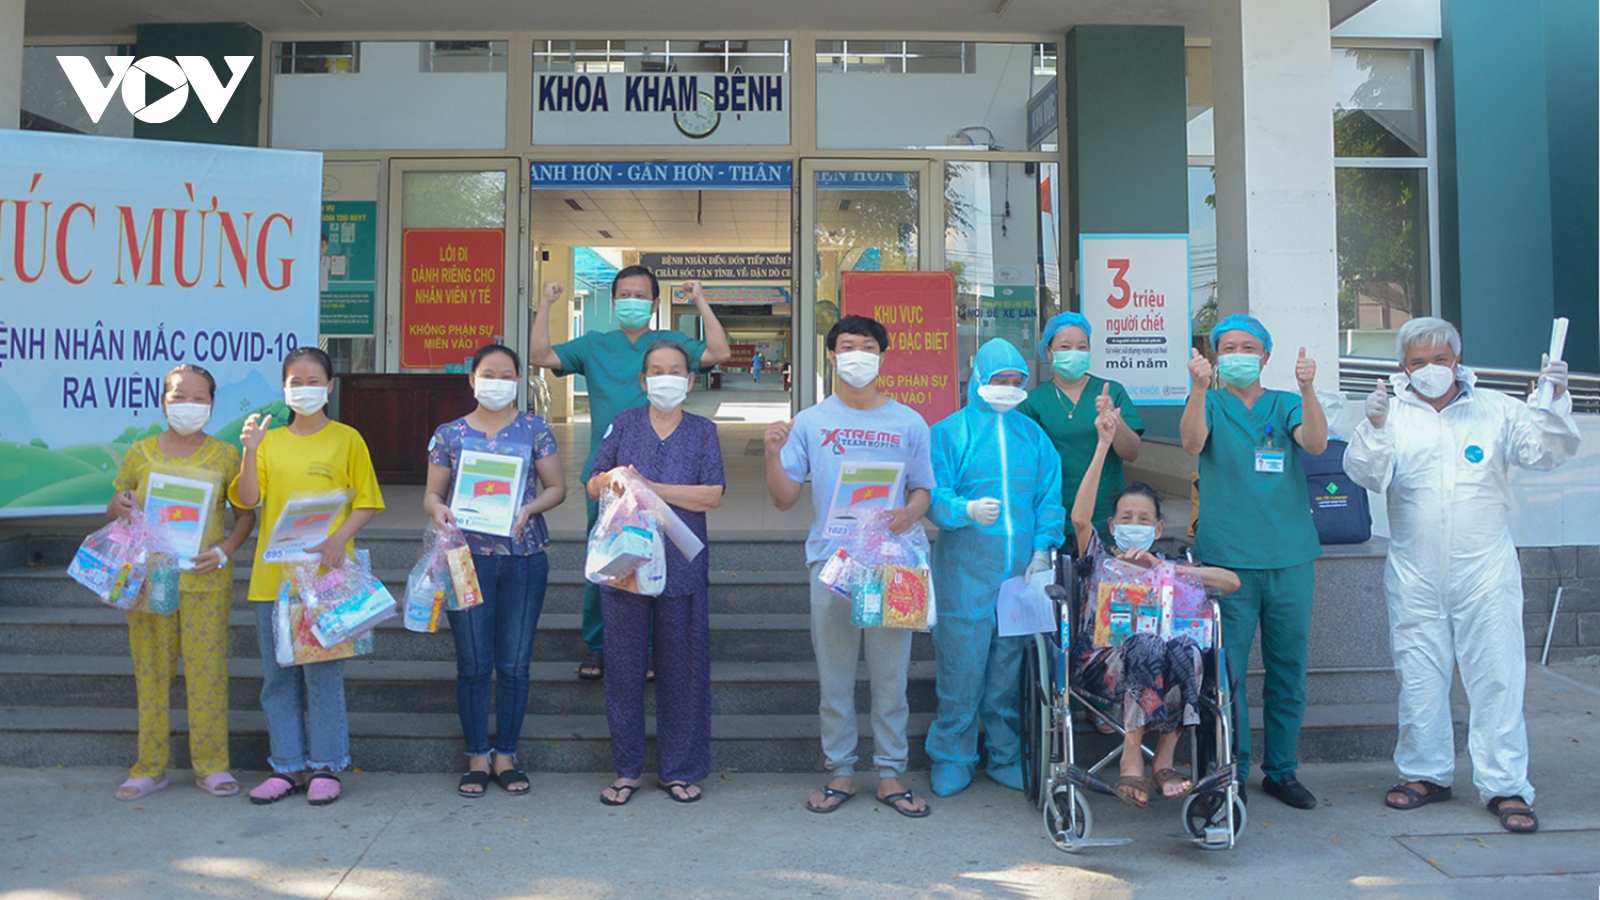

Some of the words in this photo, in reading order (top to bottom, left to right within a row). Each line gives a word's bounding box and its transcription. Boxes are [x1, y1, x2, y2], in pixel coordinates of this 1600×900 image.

[538, 75, 609, 112] KHOA
[625, 64, 698, 112] KHÁM
[714, 66, 783, 121] BỆNH
[572, 162, 613, 181] HƠN
[673, 162, 715, 181] HƠN
[729, 162, 783, 181] THÂN
[0, 172, 98, 285] ÚC
[112, 181, 296, 291] MỪNG
[440, 243, 456, 262] LỐI
[458, 246, 468, 262] ĐI
[661, 254, 683, 266] BỆNH
[684, 254, 707, 265] NHÂN
[411, 264, 439, 283] DÀNH
[441, 264, 472, 283] RIÊNG
[473, 267, 496, 283] CHO
[679, 267, 695, 278] SÓC
[415, 285, 443, 304] NHÂN
[445, 285, 467, 304] VIÊN
[469, 289, 477, 304] Y
[478, 285, 491, 304] TẾ
[1106, 259, 1131, 309] 3
[1133, 289, 1165, 313] triệu
[874, 305, 898, 324] KHU
[900, 305, 924, 329] VỰC
[1003, 308, 1016, 317] XE
[409, 322, 446, 336] KHÔNG
[479, 324, 495, 338] SỰ
[1106, 314, 1138, 335] người
[1140, 312, 1165, 331] chết
[54, 320, 124, 361] NHÂN
[133, 323, 186, 362] MẮC
[193, 330, 298, 363] COVID-19
[450, 336, 473, 349] VÀO
[899, 329, 922, 355] ĐẶC
[925, 328, 949, 355] BIỆT
[1106, 356, 1133, 369] mỗi
[1137, 357, 1168, 369] năm
[931, 374, 949, 390] SỰ
[63, 376, 98, 408] RA
[105, 371, 160, 416] VIỆN
[900, 388, 926, 404] VÀO
[842, 438, 867, 447] TEAM
[265, 549, 283, 559] 895
